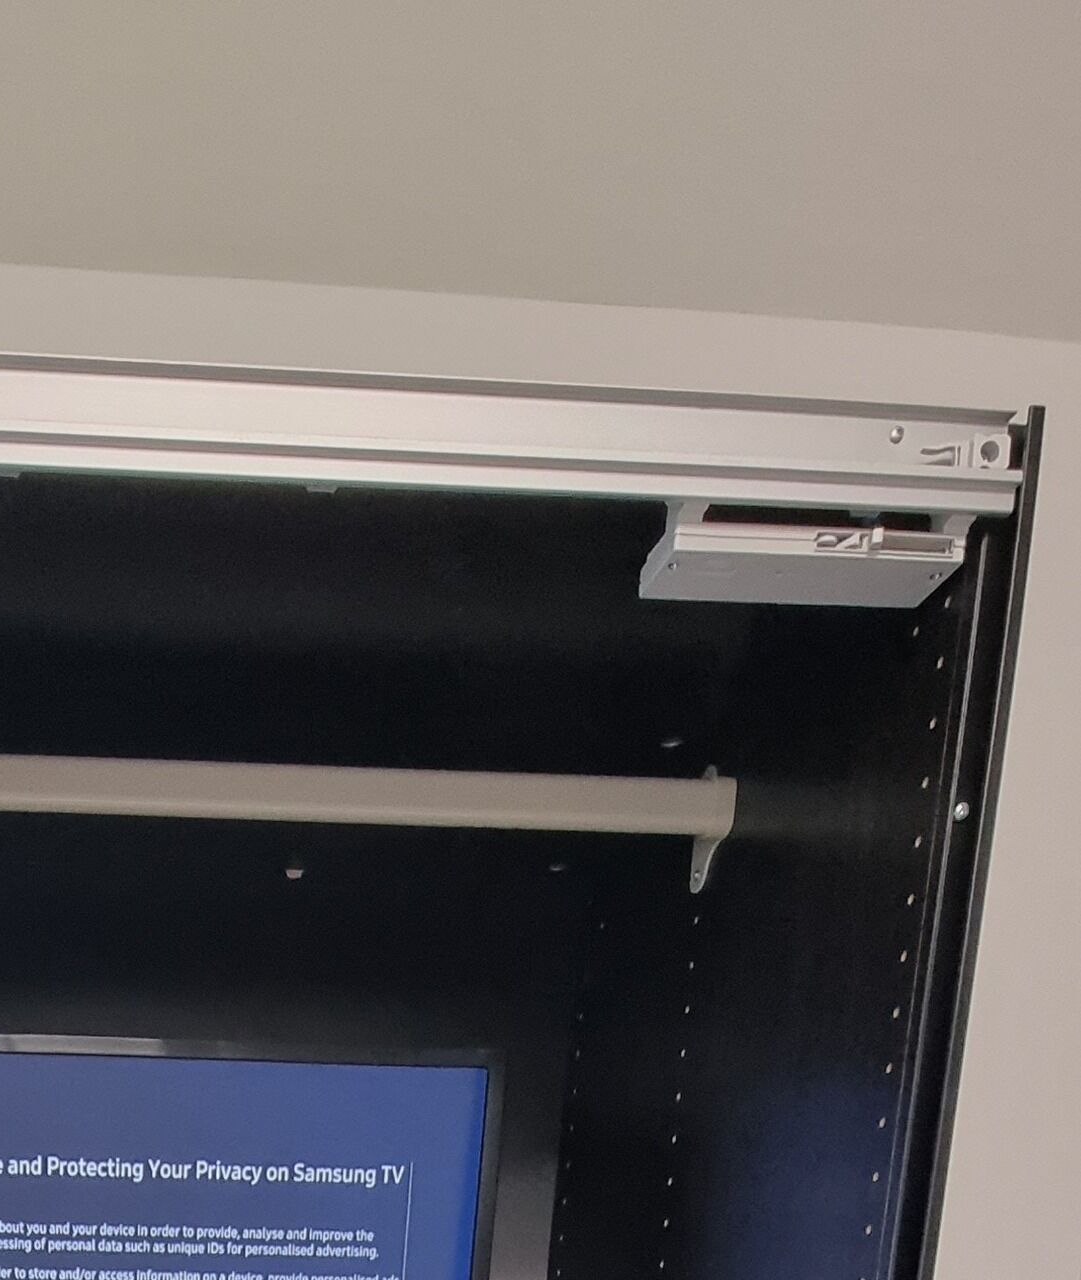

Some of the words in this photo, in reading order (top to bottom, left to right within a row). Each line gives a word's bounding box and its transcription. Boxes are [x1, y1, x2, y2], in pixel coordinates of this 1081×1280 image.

[7, 1154, 41, 1175] and
[47, 1155, 143, 1182] Protecting
[148, 1157, 191, 1178] Your
[195, 1158, 262, 1185] Privacy
[266, 1165, 289, 1180] on
[292, 1161, 376, 1188] Samsung
[380, 1163, 405, 1183] TV
[26, 1223, 46, 1238] you
[48, 1220, 70, 1235] and
[71, 1224, 97, 1239] your
[99, 1221, 135, 1236] device
[137, 1222, 148, 1236] in
[149, 1222, 180, 1237] order
[182, 1224, 194, 1237] to
[196, 1223, 240, 1242] provide,
[242, 1224, 284, 1243] analyse
[286, 1225, 307, 1240] and
[308, 1226, 354, 1245] improve
[355, 1227, 375, 1241] the
[33, 1236, 46, 1250] of
[47, 1236, 95, 1255] personal
[97, 1237, 123, 1252] data
[124, 1238, 150, 1252] such
[152, 1241, 165, 1253] as
[167, 1239, 205, 1257] unique
[207, 1240, 225, 1254] IDs
[226, 1240, 243, 1254] for
[244, 1240, 314, 1259] personalised
[315, 1242, 380, 1261] advertising.
[14, 1266, 26, 1279] to
[28, 1266, 57, 1280] store
[98, 1270, 134, 1280] access
